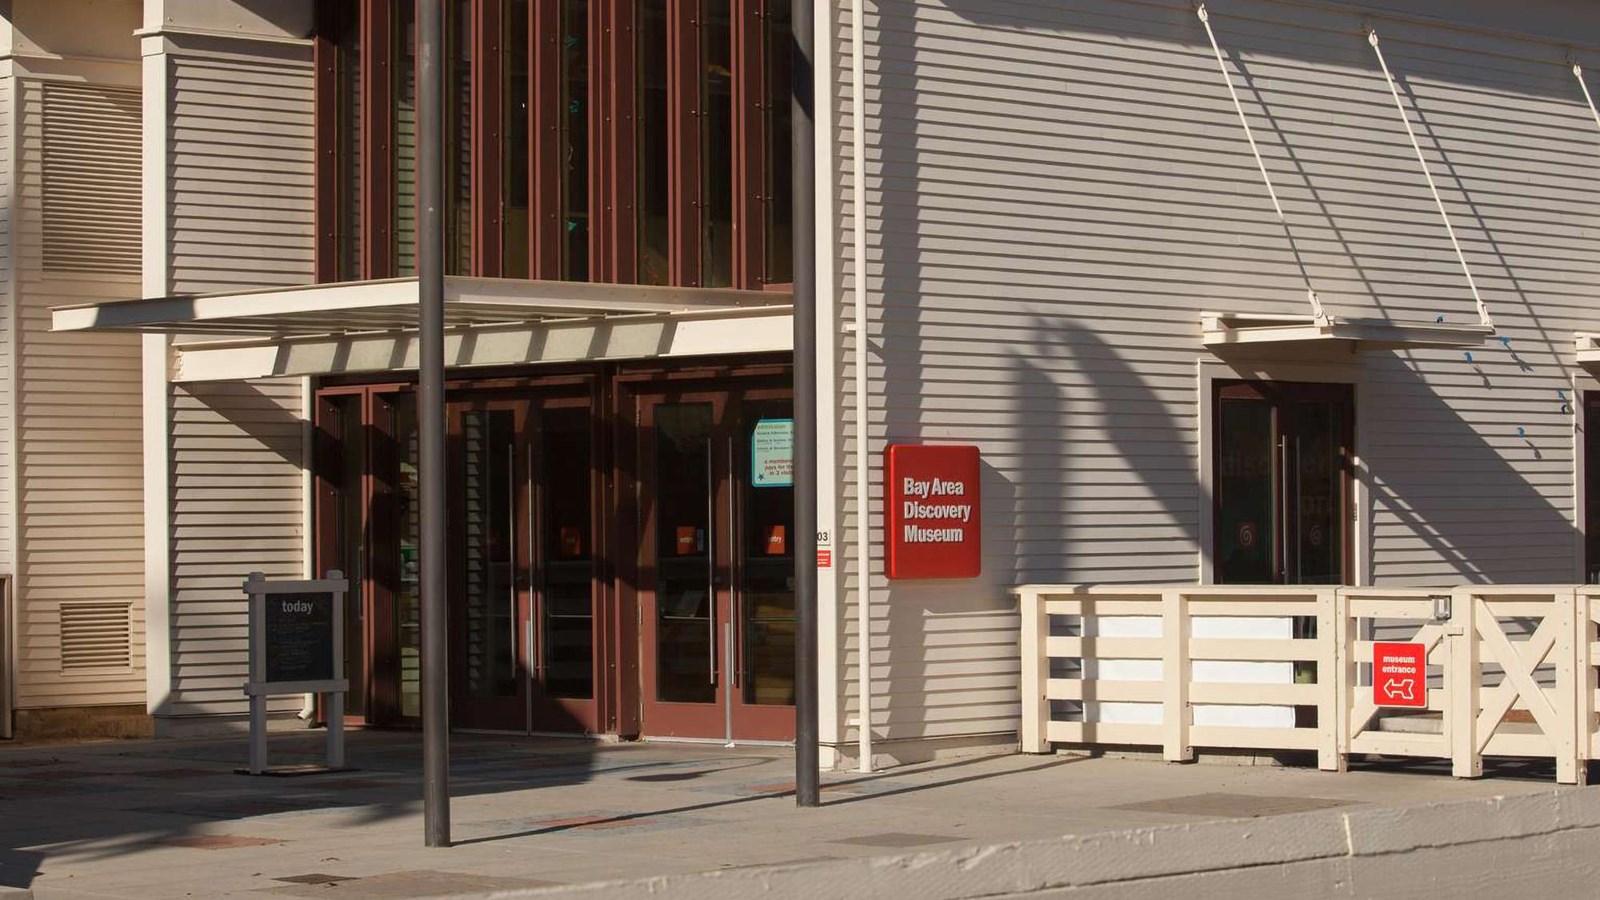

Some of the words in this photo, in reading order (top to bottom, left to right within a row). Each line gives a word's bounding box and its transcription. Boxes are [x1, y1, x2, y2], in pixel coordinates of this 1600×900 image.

[904, 477, 930, 499] Bay
[931, 477, 964, 495] Area
[904, 501, 971, 522] Discovery
[904, 525, 963, 543] Museum
[282, 600, 314, 615] today
[1383, 656, 1416, 664] museum
[1382, 665, 1417, 674] entrance
